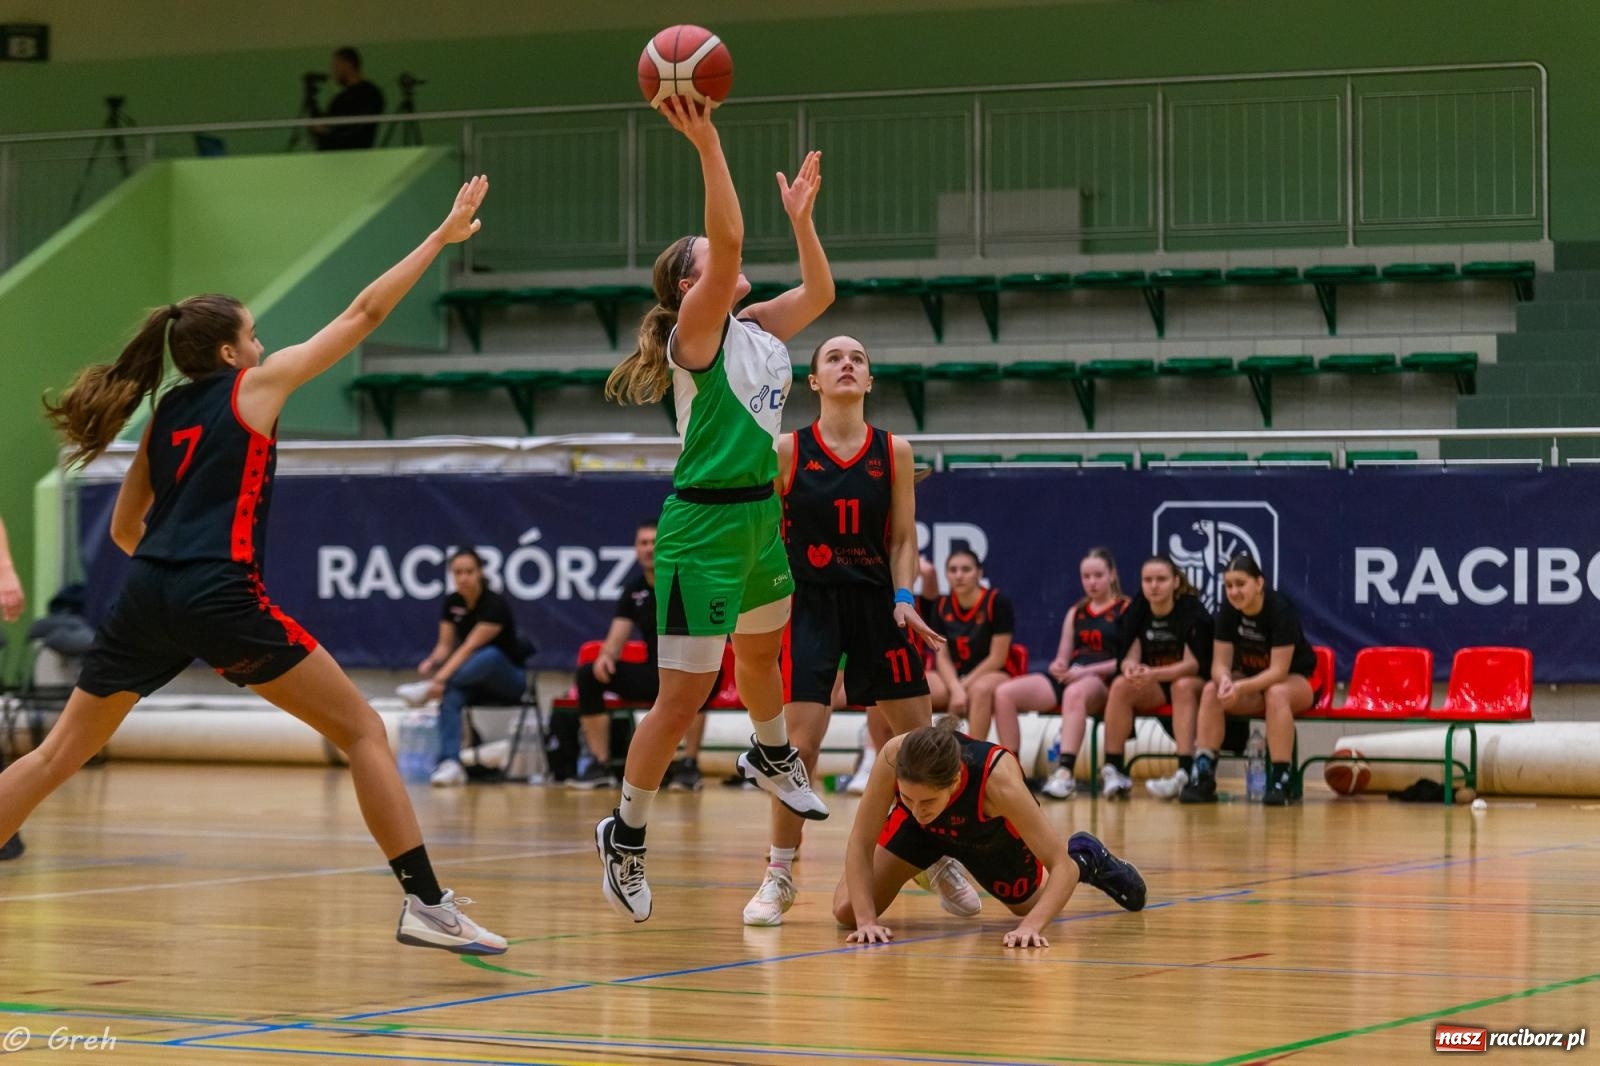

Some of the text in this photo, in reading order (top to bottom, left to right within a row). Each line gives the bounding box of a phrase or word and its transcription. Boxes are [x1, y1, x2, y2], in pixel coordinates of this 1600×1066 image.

[8, 37, 37, 58] B
[171, 424, 203, 485] 7
[833, 498, 860, 535] 11
[1354, 546, 1600, 606] RACIB
[709, 596, 728, 625] 3
[956, 636, 971, 661] 5
[885, 647, 912, 684] 11
[992, 877, 1029, 898] 00
